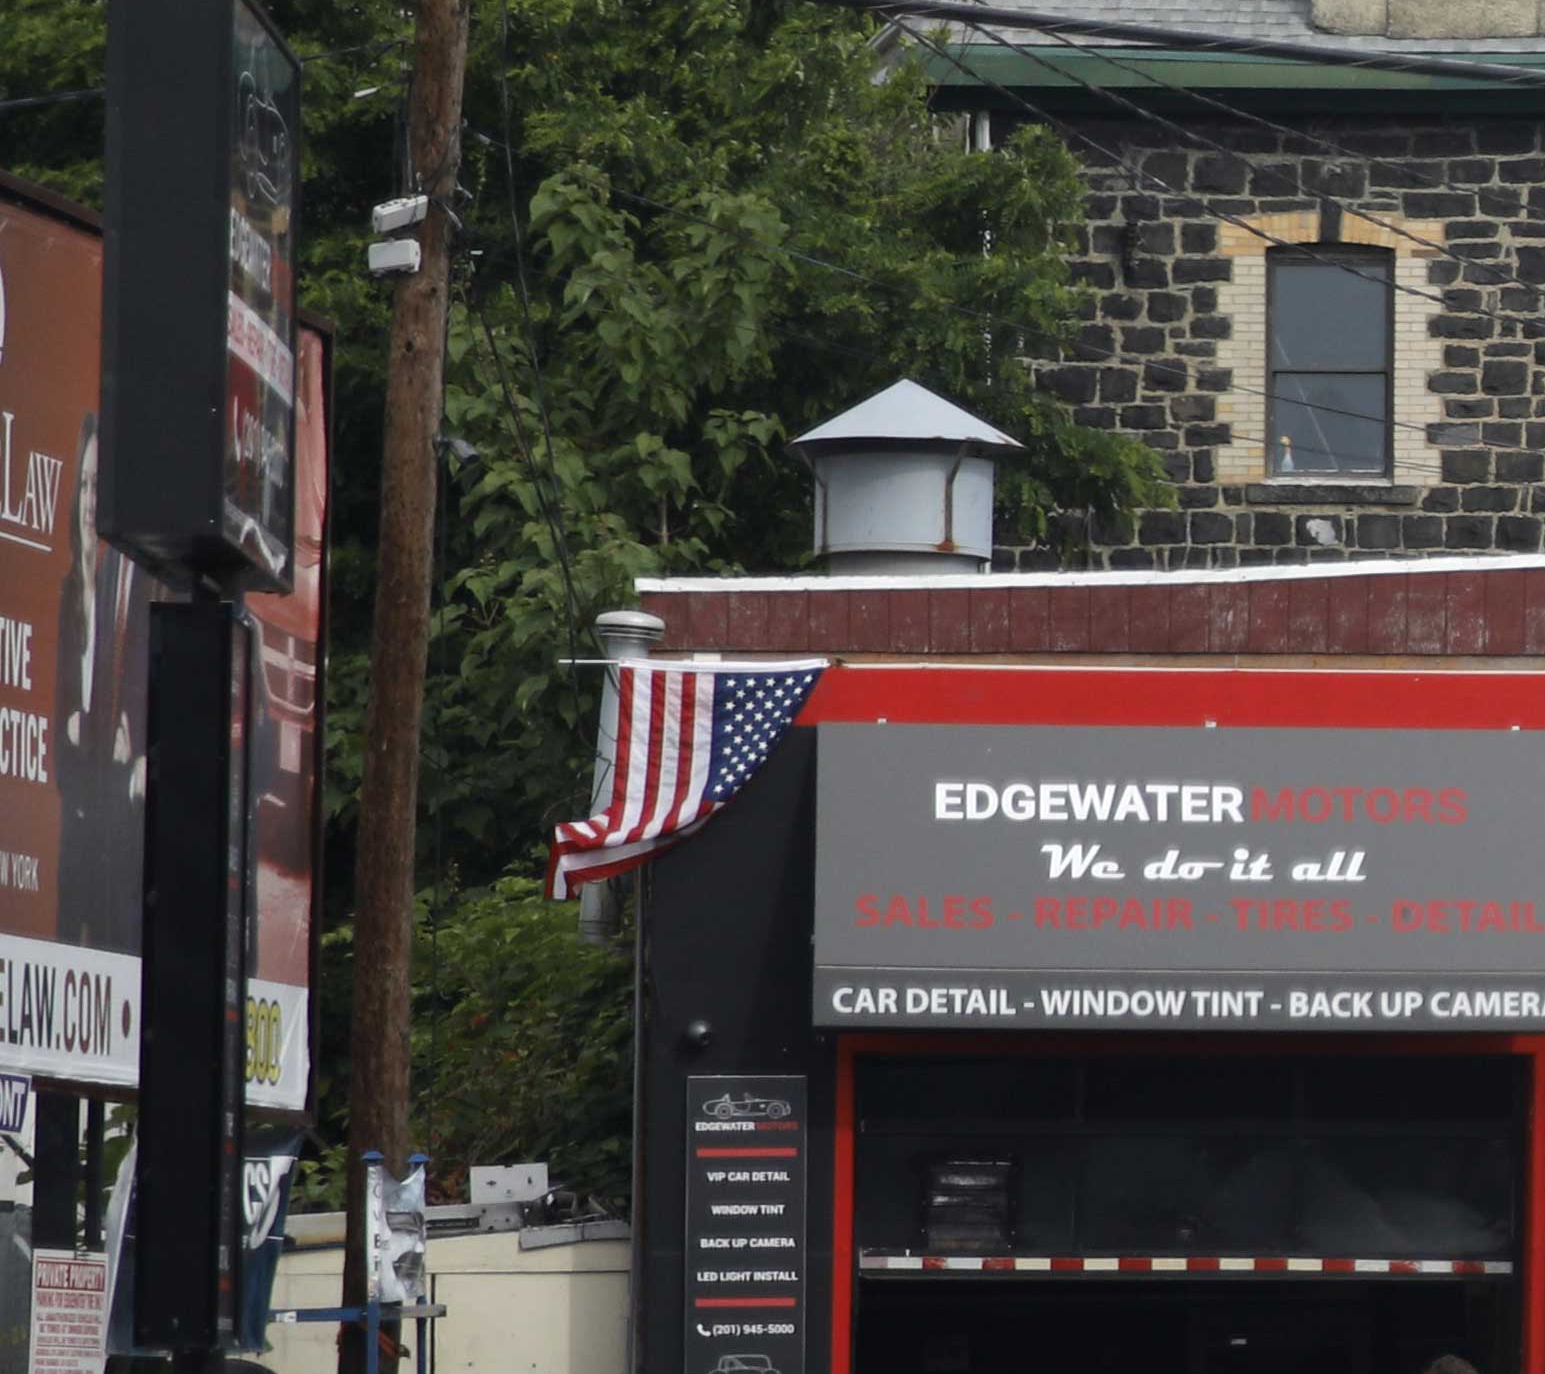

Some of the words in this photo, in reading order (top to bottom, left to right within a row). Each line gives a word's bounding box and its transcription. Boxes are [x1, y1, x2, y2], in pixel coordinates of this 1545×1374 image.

[1, 411, 63, 535] LAW
[934, 782, 1244, 824] EDGEWATER
[1250, 785, 1470, 826] MOTORS
[1041, 843, 1125, 882] We
[1143, 843, 1222, 883] do
[1226, 848, 1273, 883] it
[1291, 849, 1368, 884] all
[854, 893, 996, 930] SALES
[1034, 895, 1196, 932] REPAIR
[1229, 897, 1356, 933] TIRES
[832, 986, 898, 1017] CAR
[906, 987, 1017, 1018] DETAIL
[1040, 988, 1187, 1019] WINDOW
[1190, 989, 1264, 1020] TINT
[1288, 990, 1375, 1020] BACK
[1380, 990, 1424, 1020] UP
[695, 1121, 755, 1131] EDGEWATER
[707, 1171, 726, 1182] VIP
[728, 1171, 750, 1182] CAR
[752, 1171, 790, 1182] DETAIL
[711, 1204, 760, 1215] WINDOW
[761, 1204, 786, 1215] TINT
[700, 1238, 731, 1248] BACK
[732, 1238, 748, 1248] UP
[749, 1237, 796, 1248] CAMERA
[697, 1271, 718, 1282] LED
[719, 1271, 752, 1282] LIGHT
[753, 1271, 799, 1282] INSTALL
[711, 1323, 741, 1336] (201)
[742, 1324, 795, 1335] 945-5000
